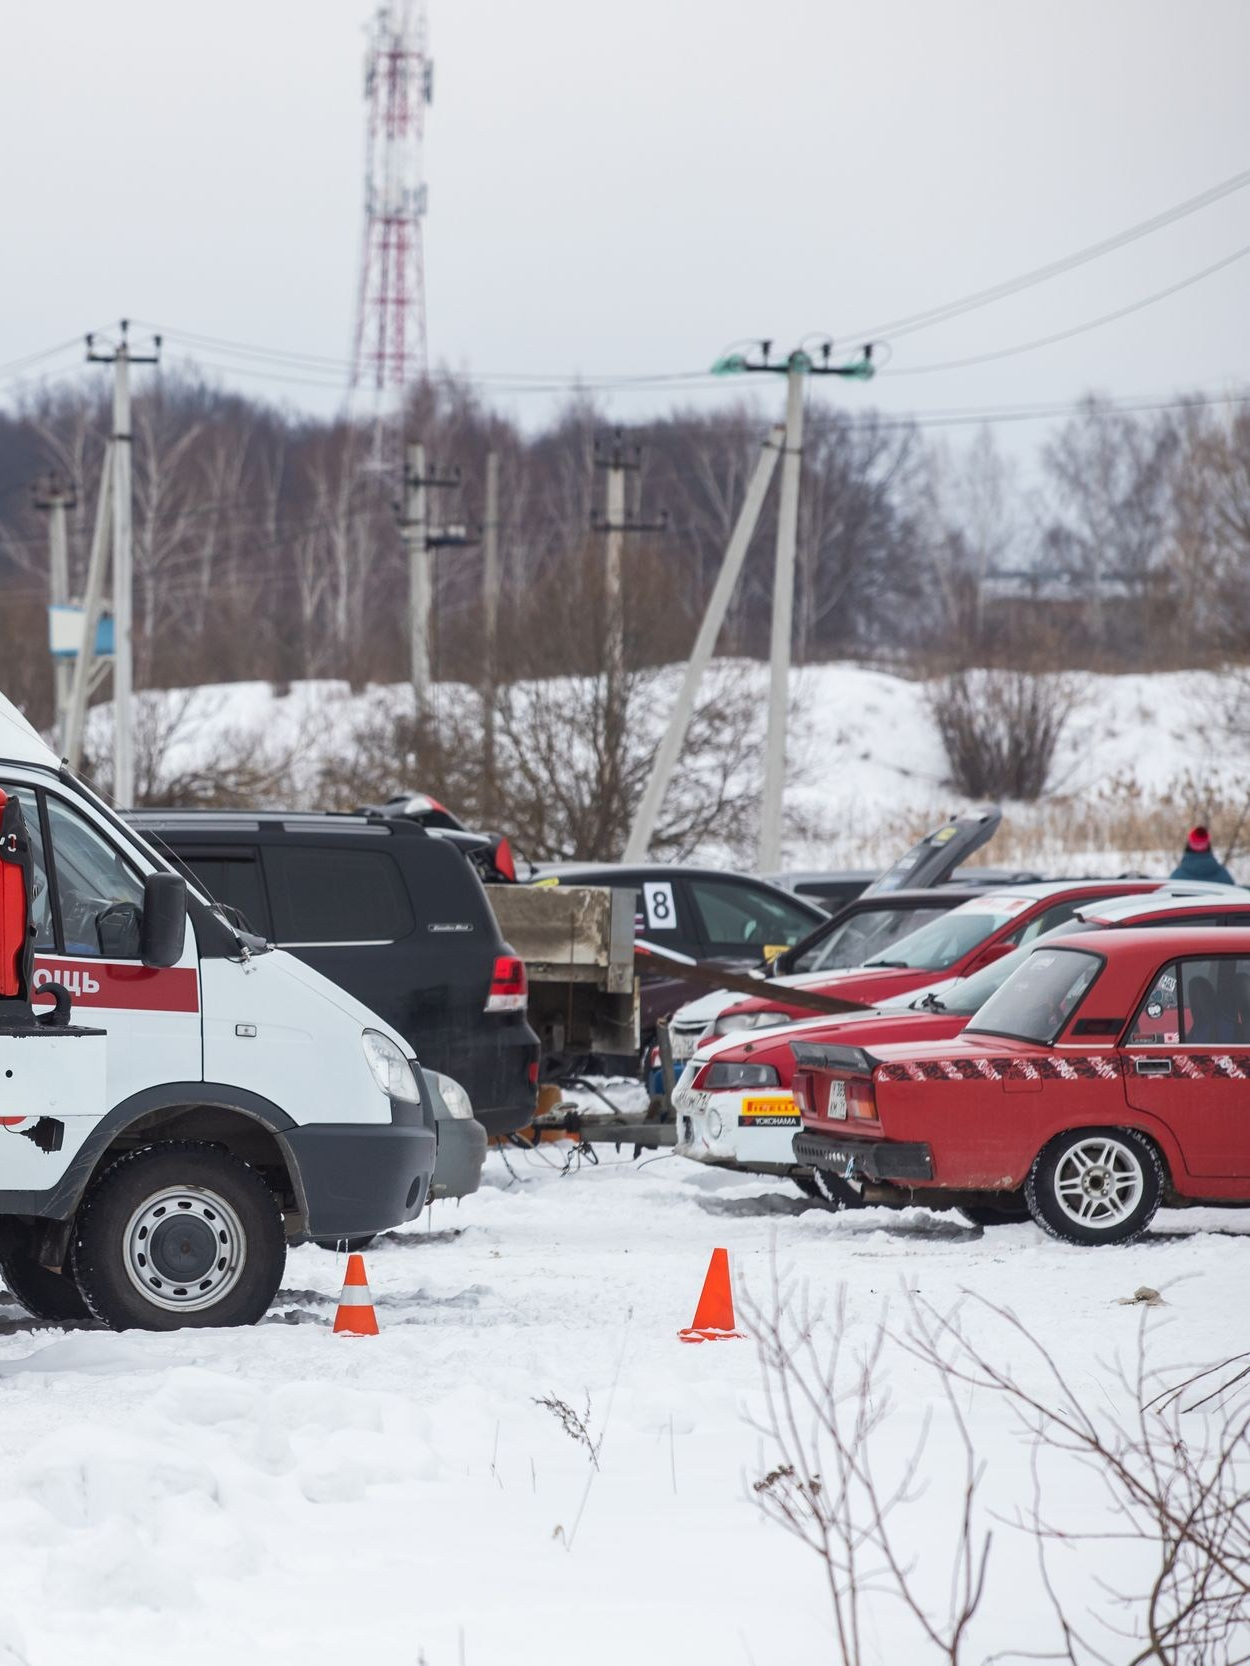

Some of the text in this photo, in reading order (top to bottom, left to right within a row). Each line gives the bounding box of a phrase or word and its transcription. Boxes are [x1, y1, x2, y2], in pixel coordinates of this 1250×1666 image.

[653, 891, 670, 920] 8
[32, 968, 100, 997] ОЩЬ
[755, 1117, 797, 1126] YOKOHAMA
